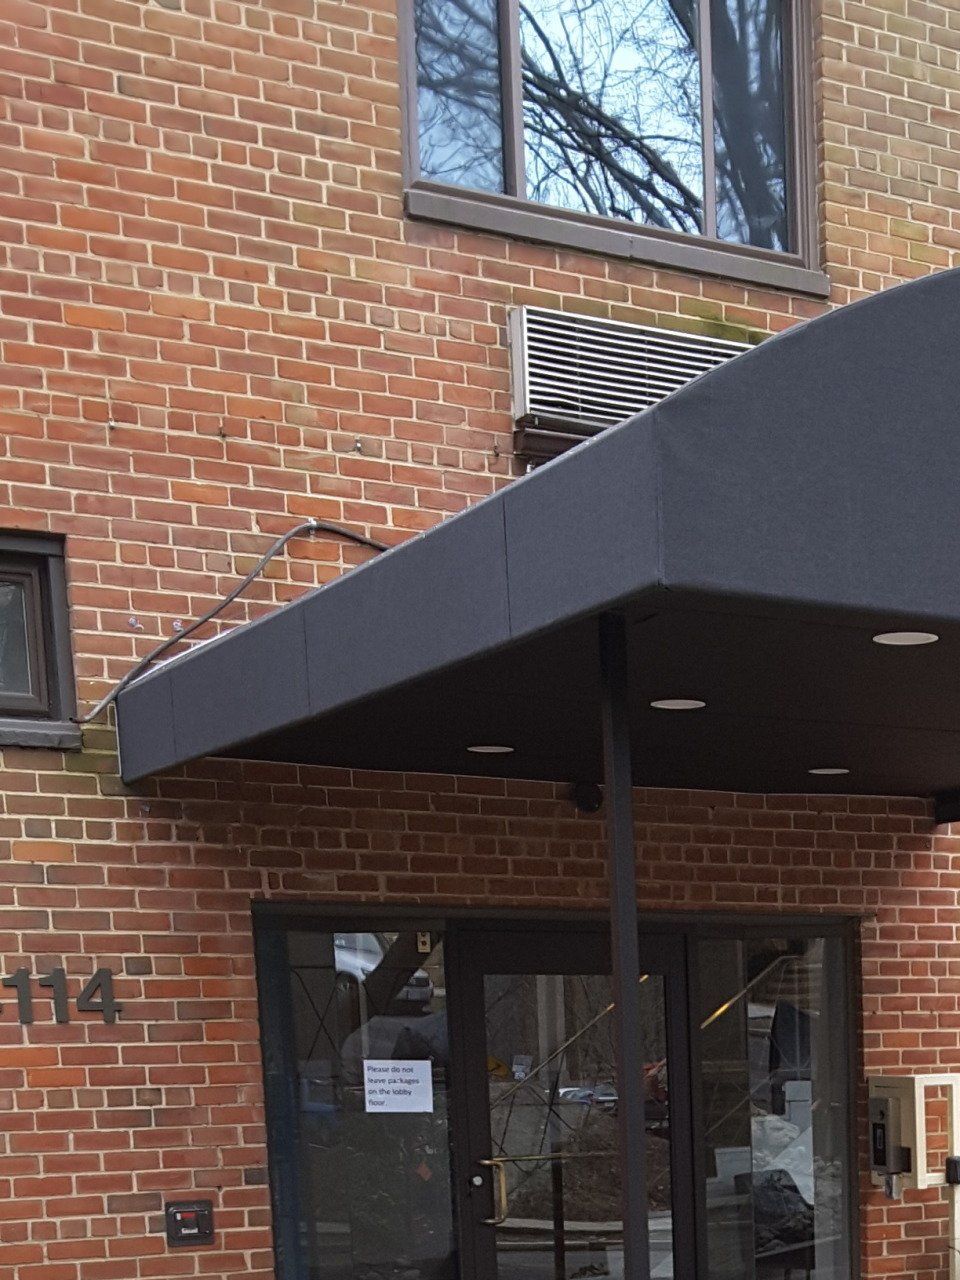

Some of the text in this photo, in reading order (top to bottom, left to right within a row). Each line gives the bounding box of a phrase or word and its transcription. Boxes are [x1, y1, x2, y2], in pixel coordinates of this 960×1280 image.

[0, 967, 122, 1024] 114
[367, 1065, 389, 1073] Please
[391, 1065, 400, 1073] do
[392, 1088, 413, 1096] lobby
